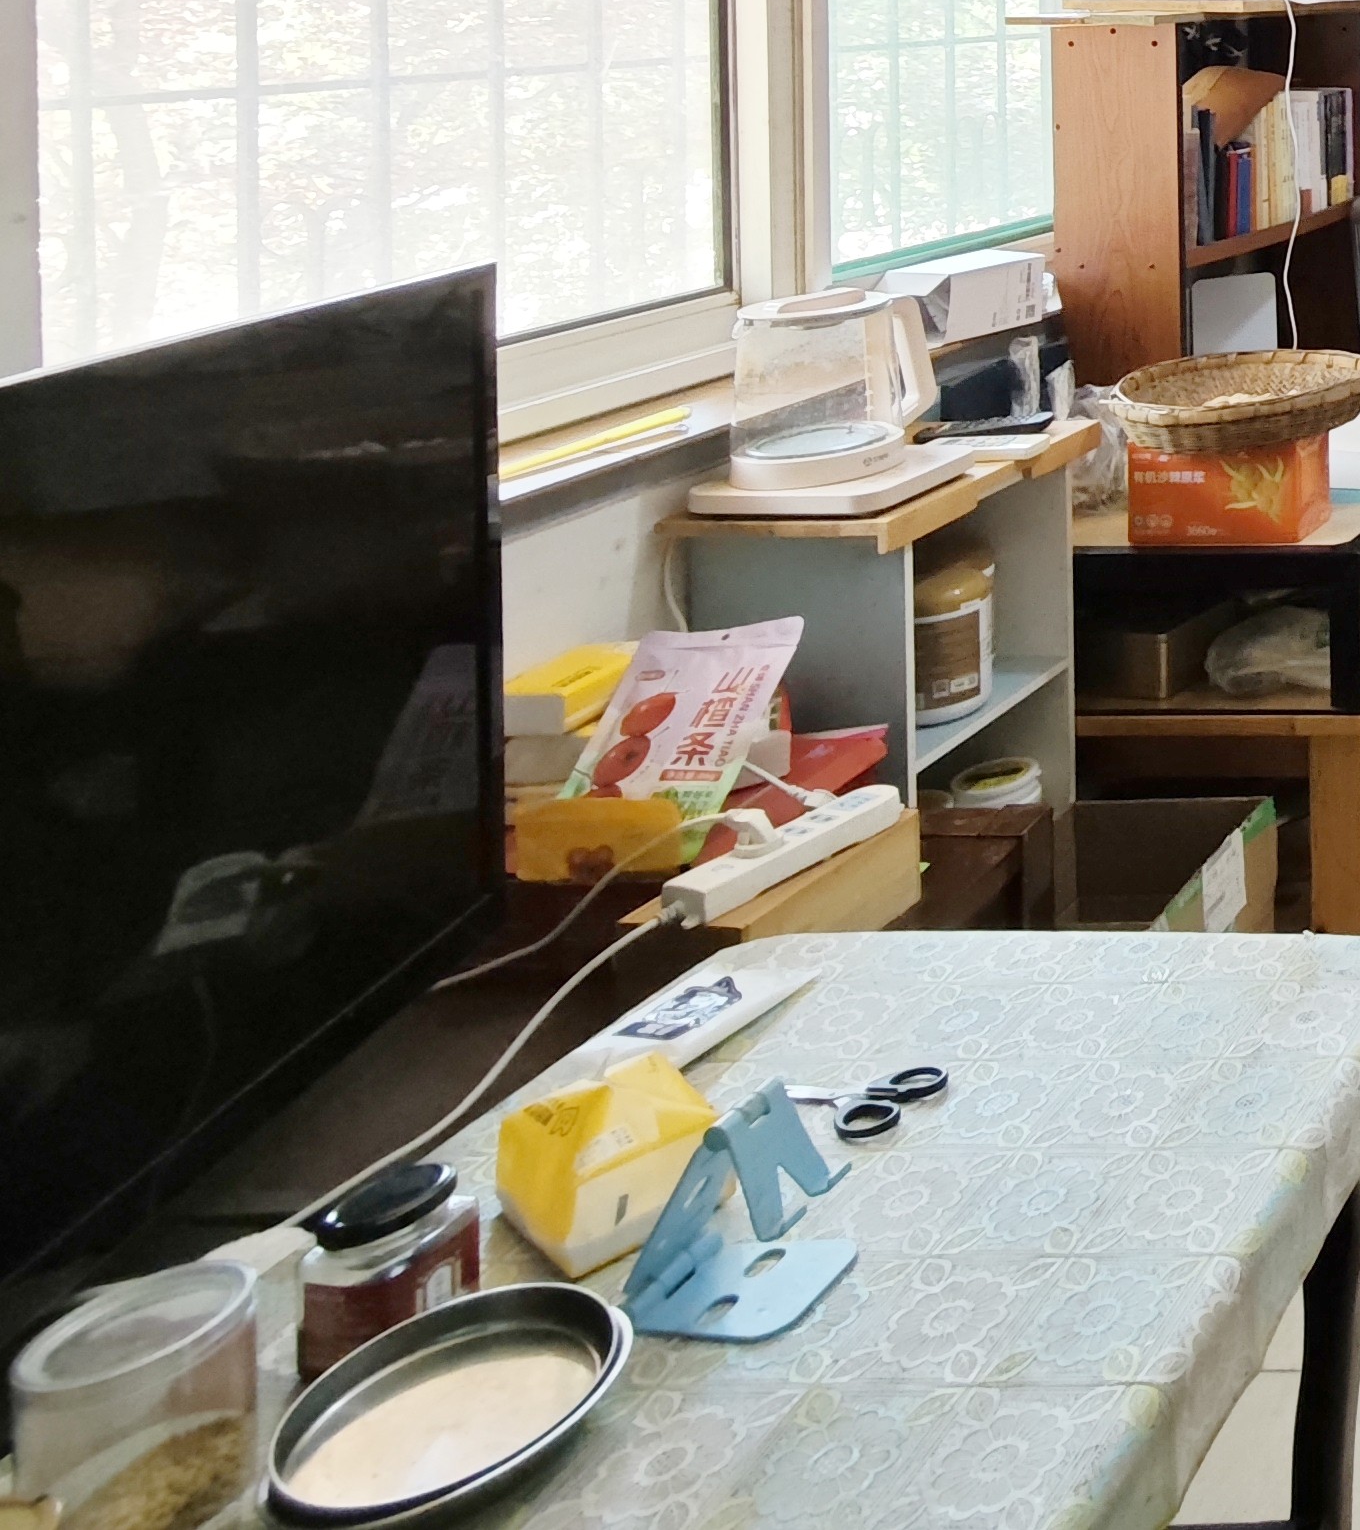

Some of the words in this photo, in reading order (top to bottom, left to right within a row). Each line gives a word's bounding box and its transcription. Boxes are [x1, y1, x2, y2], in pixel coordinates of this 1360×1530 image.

[670, 667, 754, 767] 山楂条
[729, 713, 746, 737] ZHA
[715, 738, 735, 768] TIAO
